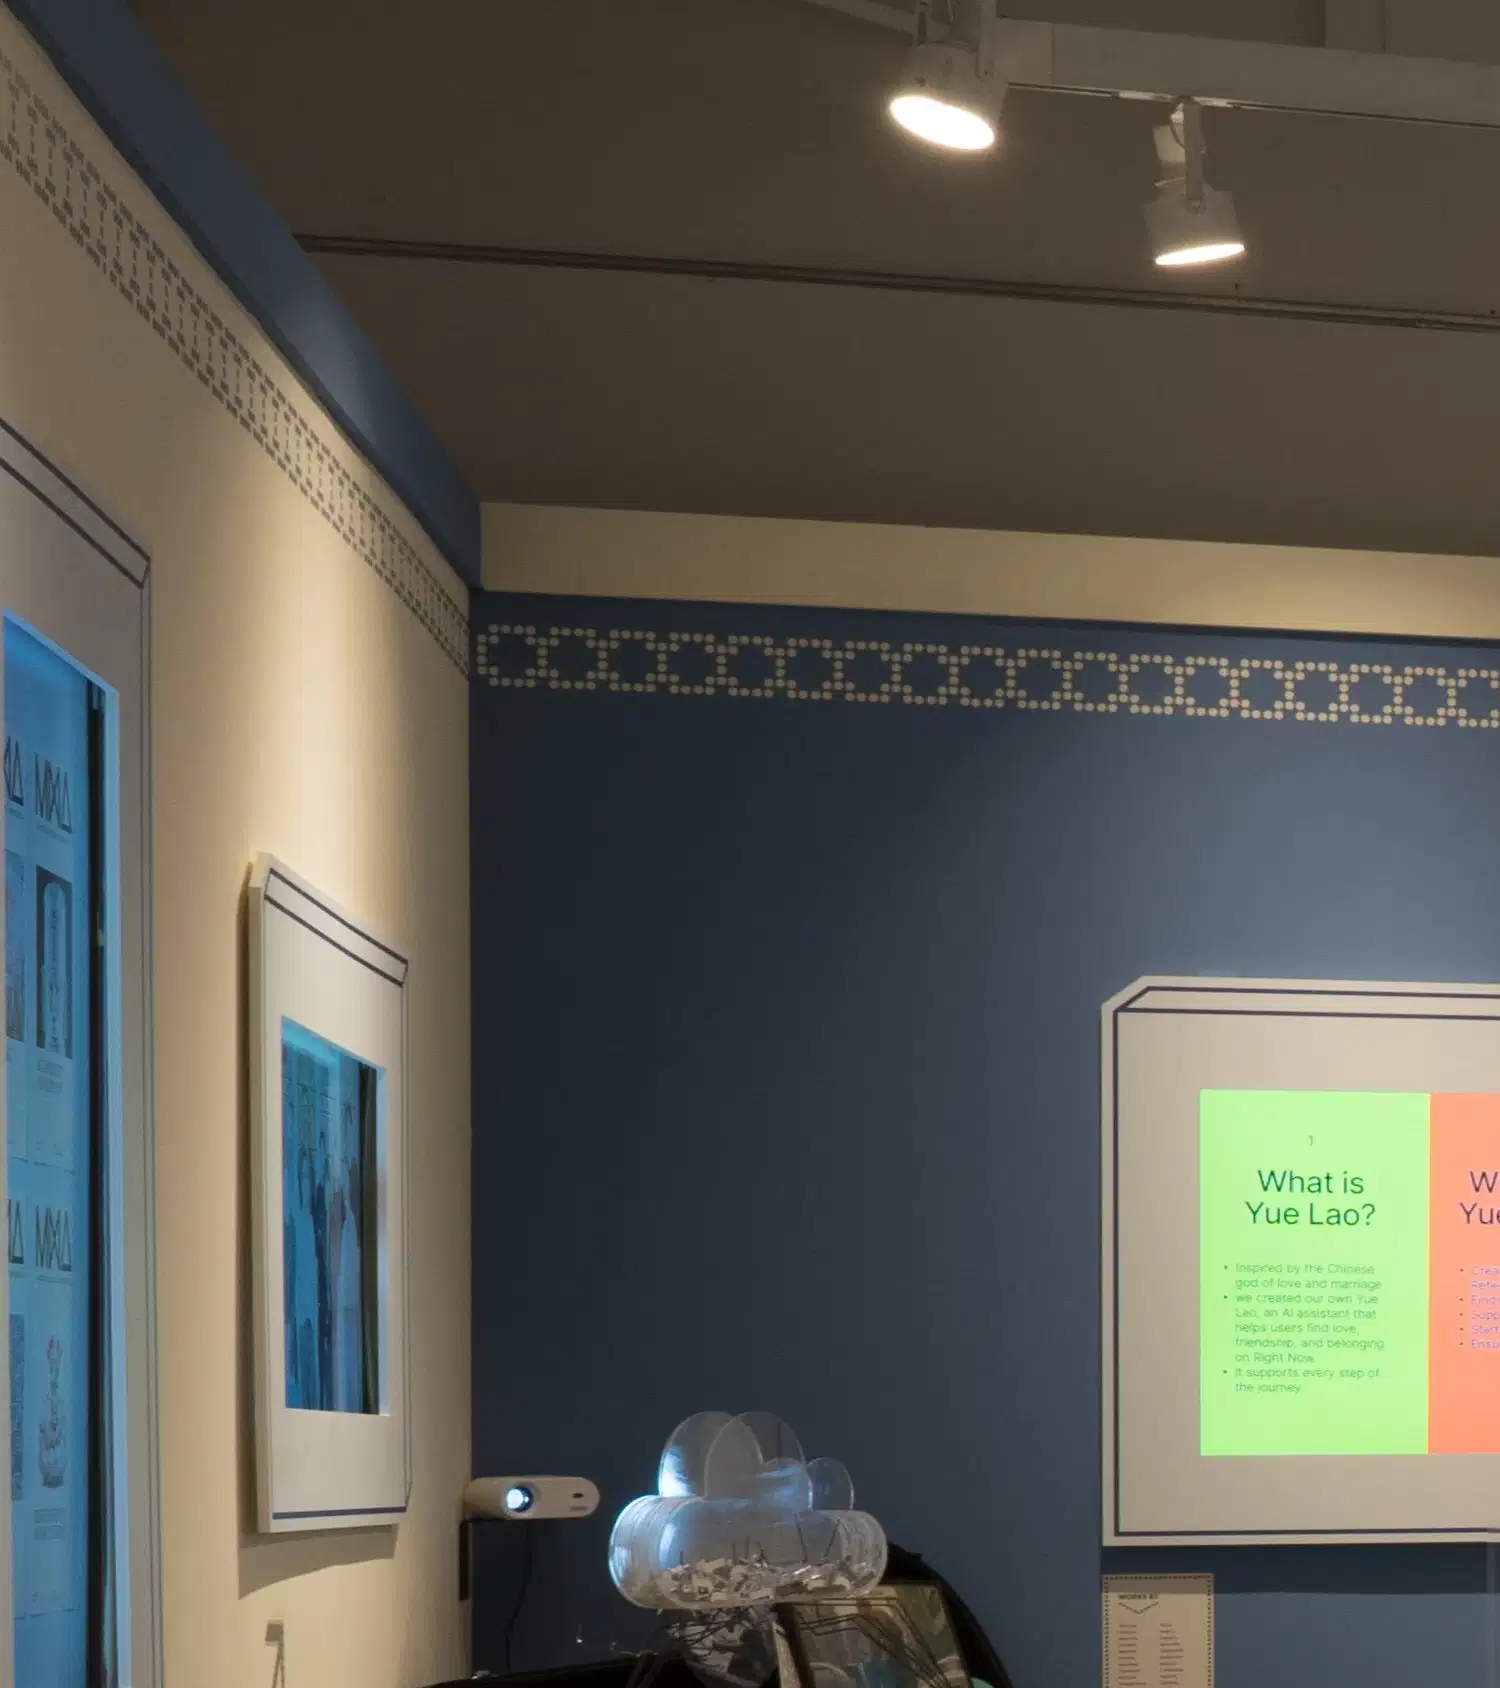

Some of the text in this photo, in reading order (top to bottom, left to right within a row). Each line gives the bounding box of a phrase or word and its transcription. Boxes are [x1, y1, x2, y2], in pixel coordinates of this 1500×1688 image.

[1257, 1169, 1364, 1194] What is
[1245, 1201, 1376, 1226] Yue Lao?
